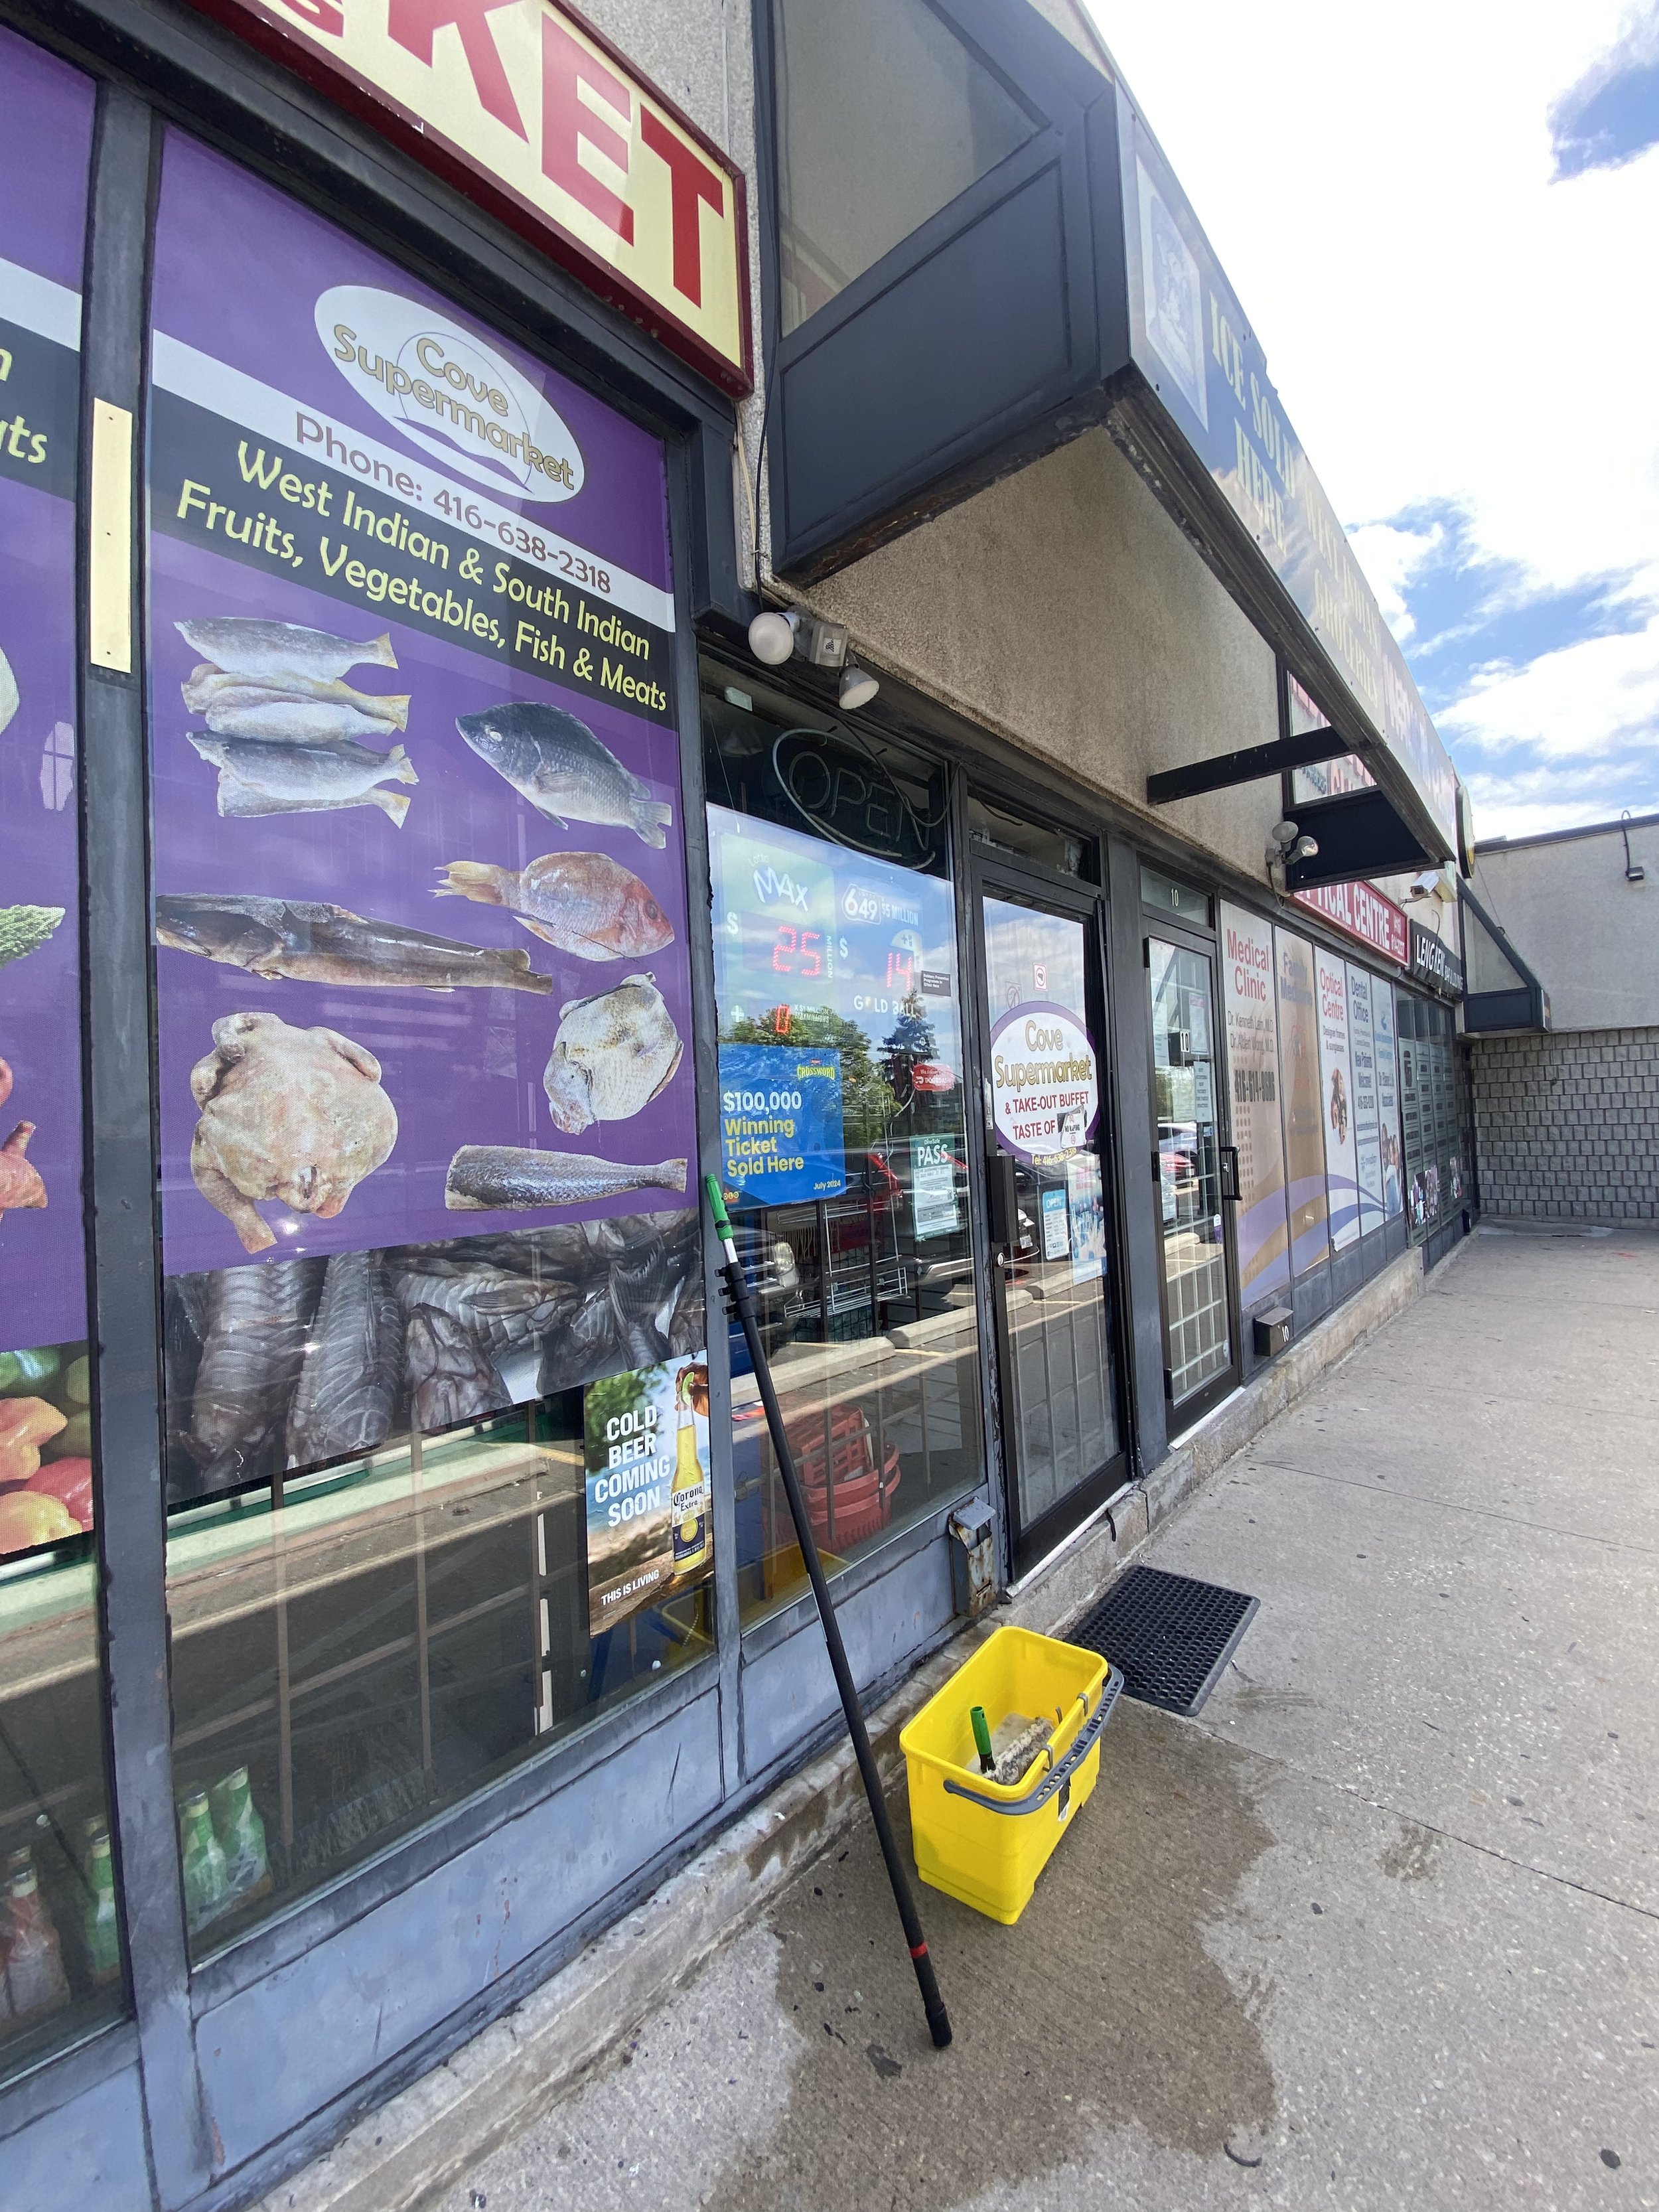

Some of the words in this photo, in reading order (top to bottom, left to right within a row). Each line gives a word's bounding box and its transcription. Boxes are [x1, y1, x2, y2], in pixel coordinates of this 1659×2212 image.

[417, 337, 508, 416] Cove
[334, 325, 573, 490] Supermarket
[1210, 289, 1246, 410] ICE
[1250, 372, 1295, 499] SOLD
[297, 410, 422, 501] Phone:
[433, 490, 611, 593] 416-638-2318
[1234, 417, 1286, 556] HERE
[238, 440, 332, 516] West
[342, 490, 449, 569] Indian
[459, 548, 484, 585] &
[492, 562, 569, 623] South
[577, 600, 650, 660] Indian
[177, 479, 304, 567] Fruits,
[321, 536, 506, 648] Vegetables,
[515, 621, 565, 669] Fish
[573, 647, 594, 682] &
[600, 657, 667, 711] Meats
[789, 751, 930, 851] OPEN
[753, 867, 808, 912] MAX
[845, 888, 878, 921] 649
[1171, 888, 1179, 907] 10
[881, 903, 890, 917] $5
[891, 905, 918, 926] MILLION
[1353, 883, 1390, 950] CENTRE
[727, 911, 739, 935] $
[772, 925, 821, 976] 25
[1227, 929, 1269, 972] Medical
[839, 936, 848, 960] $
[887, 952, 913, 991] 14
[1234, 966, 1266, 1001] Clinic
[1320, 967, 1342, 997] Optical
[1351, 976, 1368, 1000] Dental
[893, 1002, 916, 1018] BALL
[1322, 994, 1344, 1021] Centre
[1353, 1000, 1368, 1023] Office
[1025, 1020, 1063, 1051] Cove
[1181, 1032, 1189, 1051] 10
[797, 1065, 835, 1080] CROSSWORD
[995, 1053, 1092, 1092] Supermarket
[723, 1090, 802, 1115] $100,000
[1005, 1102, 1011, 1114] &
[1013, 1095, 1057, 1113] TAKE-OUT
[1060, 1091, 1089, 1107] BUFFET
[725, 1116, 794, 1138] Winning
[1013, 1122, 1043, 1140] TASTE
[1045, 1120, 1056, 1137] OF
[725, 1137, 777, 1157] Ticket
[918, 1144, 948, 1166] PASS
[1031, 1153, 1041, 1165] Tel:
[727, 1157, 763, 1177] Sold
[767, 1156, 804, 1173] Here
[814, 1181, 826, 1191] July
[827, 1180, 841, 1189] 2024
[1046, 1199, 1062, 1209] OPEN
[607, 1406, 657, 1441] COLD
[609, 1433, 656, 1469] BEER
[595, 1455, 670, 1503] COMING
[608, 1486, 660, 1527] SOON
[674, 1486, 703, 1507] Corona
[680, 1500, 698, 1511] Extra
[601, 1587, 621, 1605] THIS
[623, 1583, 631, 1595] IS
[632, 1569, 660, 1590] LIVING
